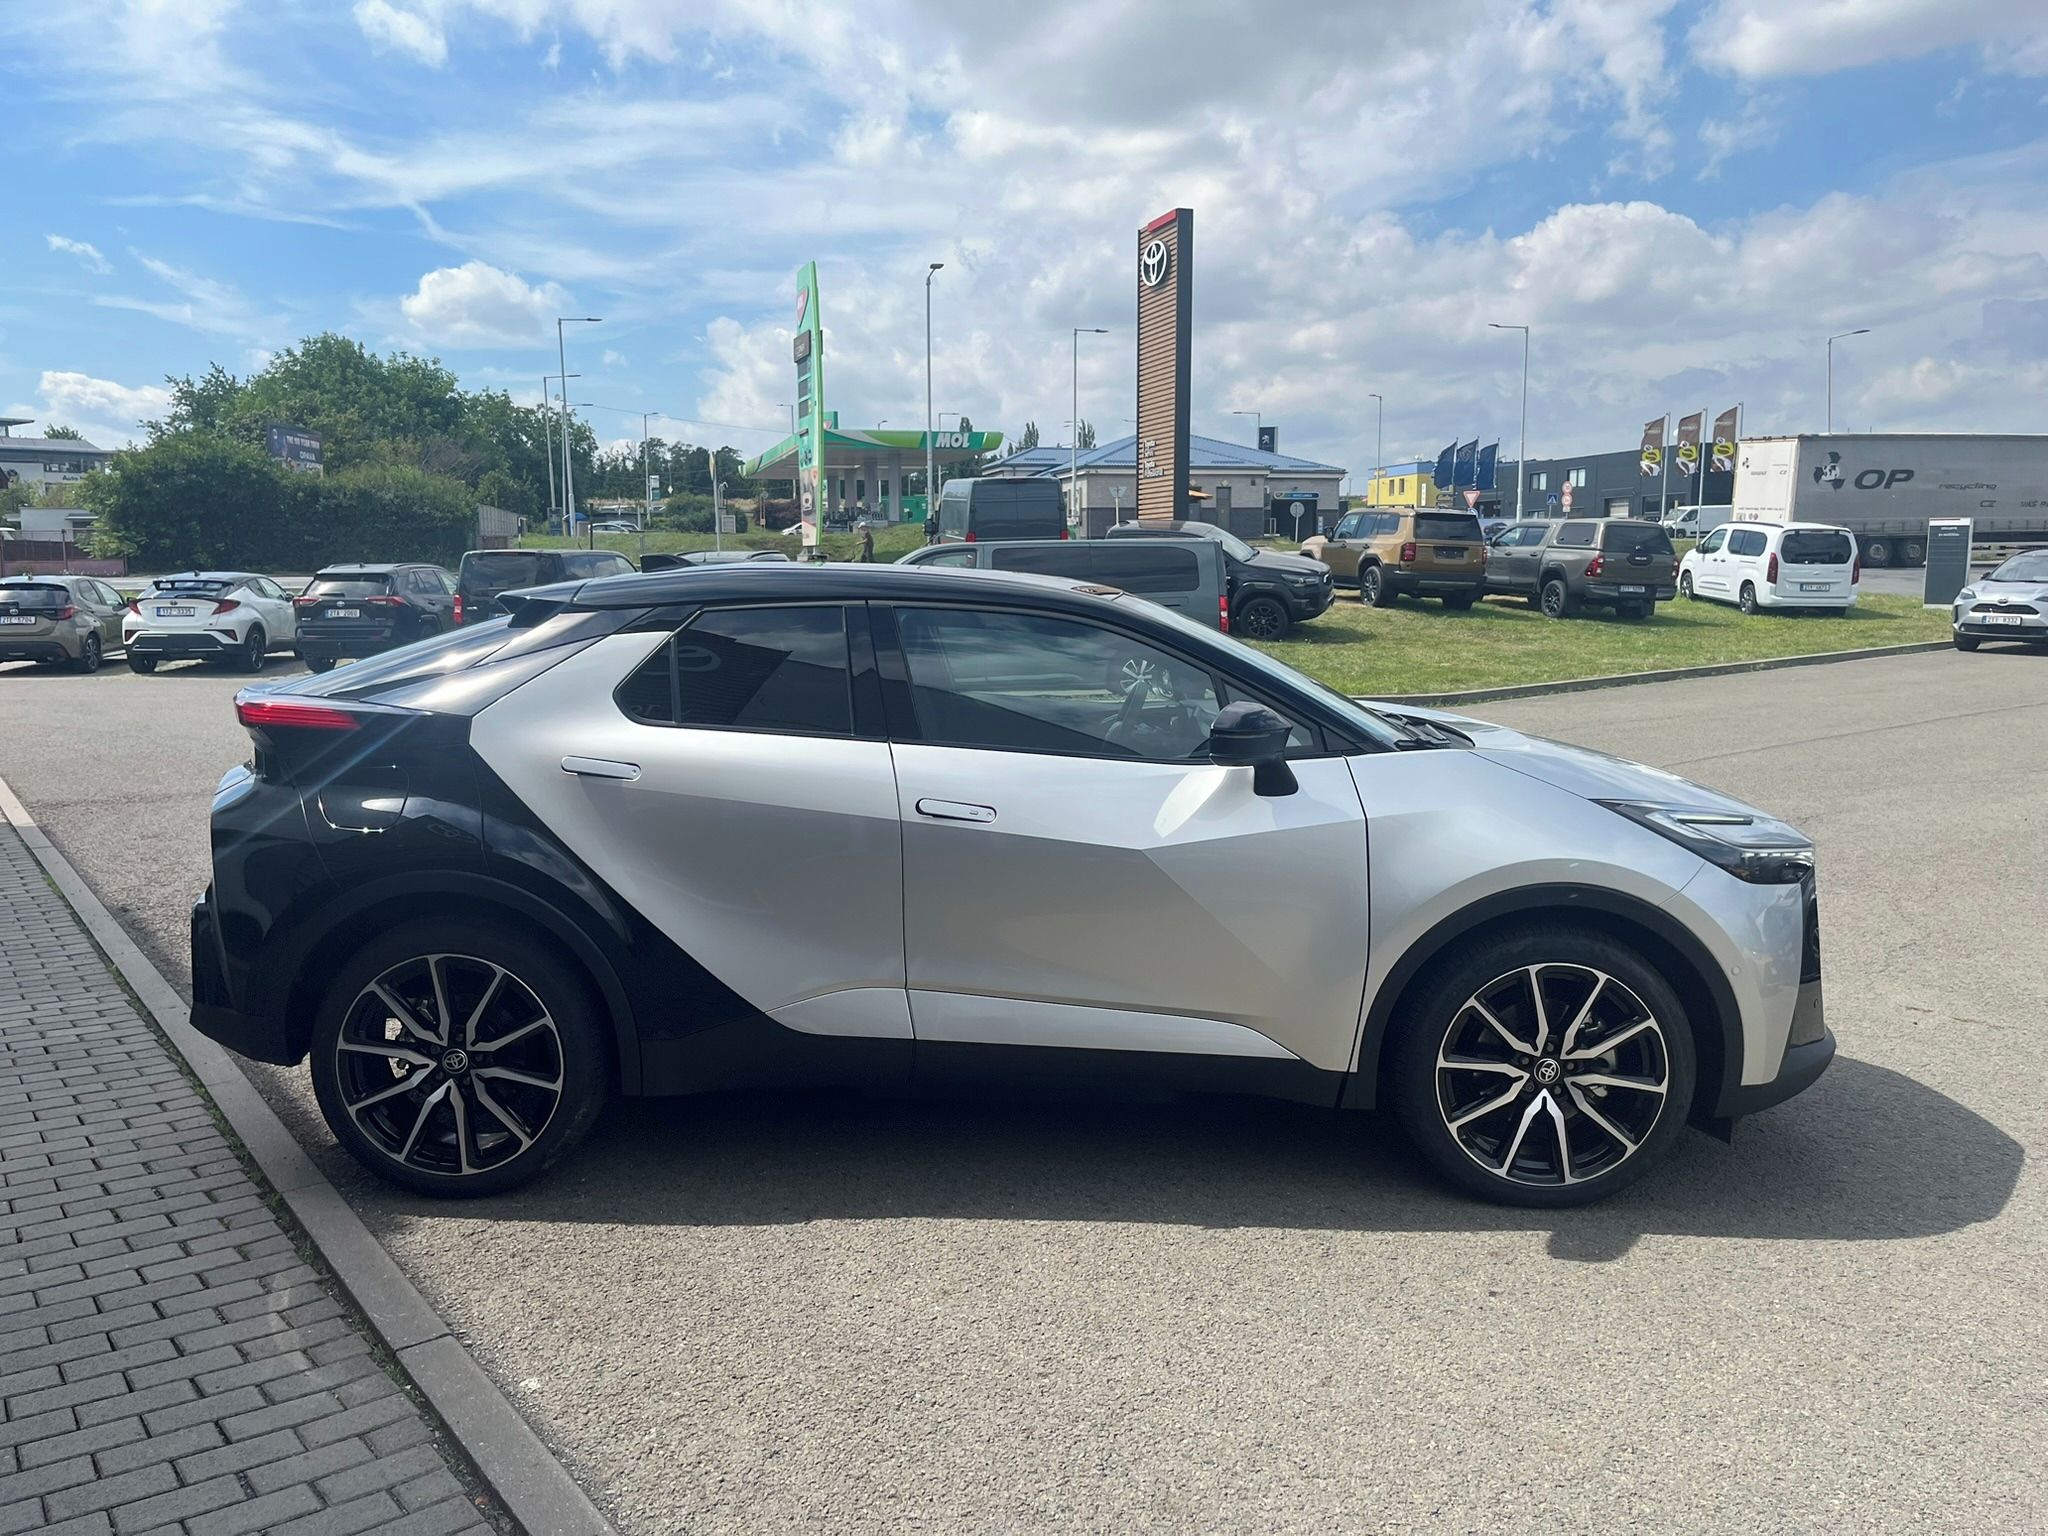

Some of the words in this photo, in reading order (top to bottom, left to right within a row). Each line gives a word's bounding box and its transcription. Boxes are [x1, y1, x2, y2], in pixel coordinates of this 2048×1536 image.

[935, 432, 970, 448] MOL
[1854, 469, 1914, 490] OP
[1938, 482, 1998, 491] recycling
